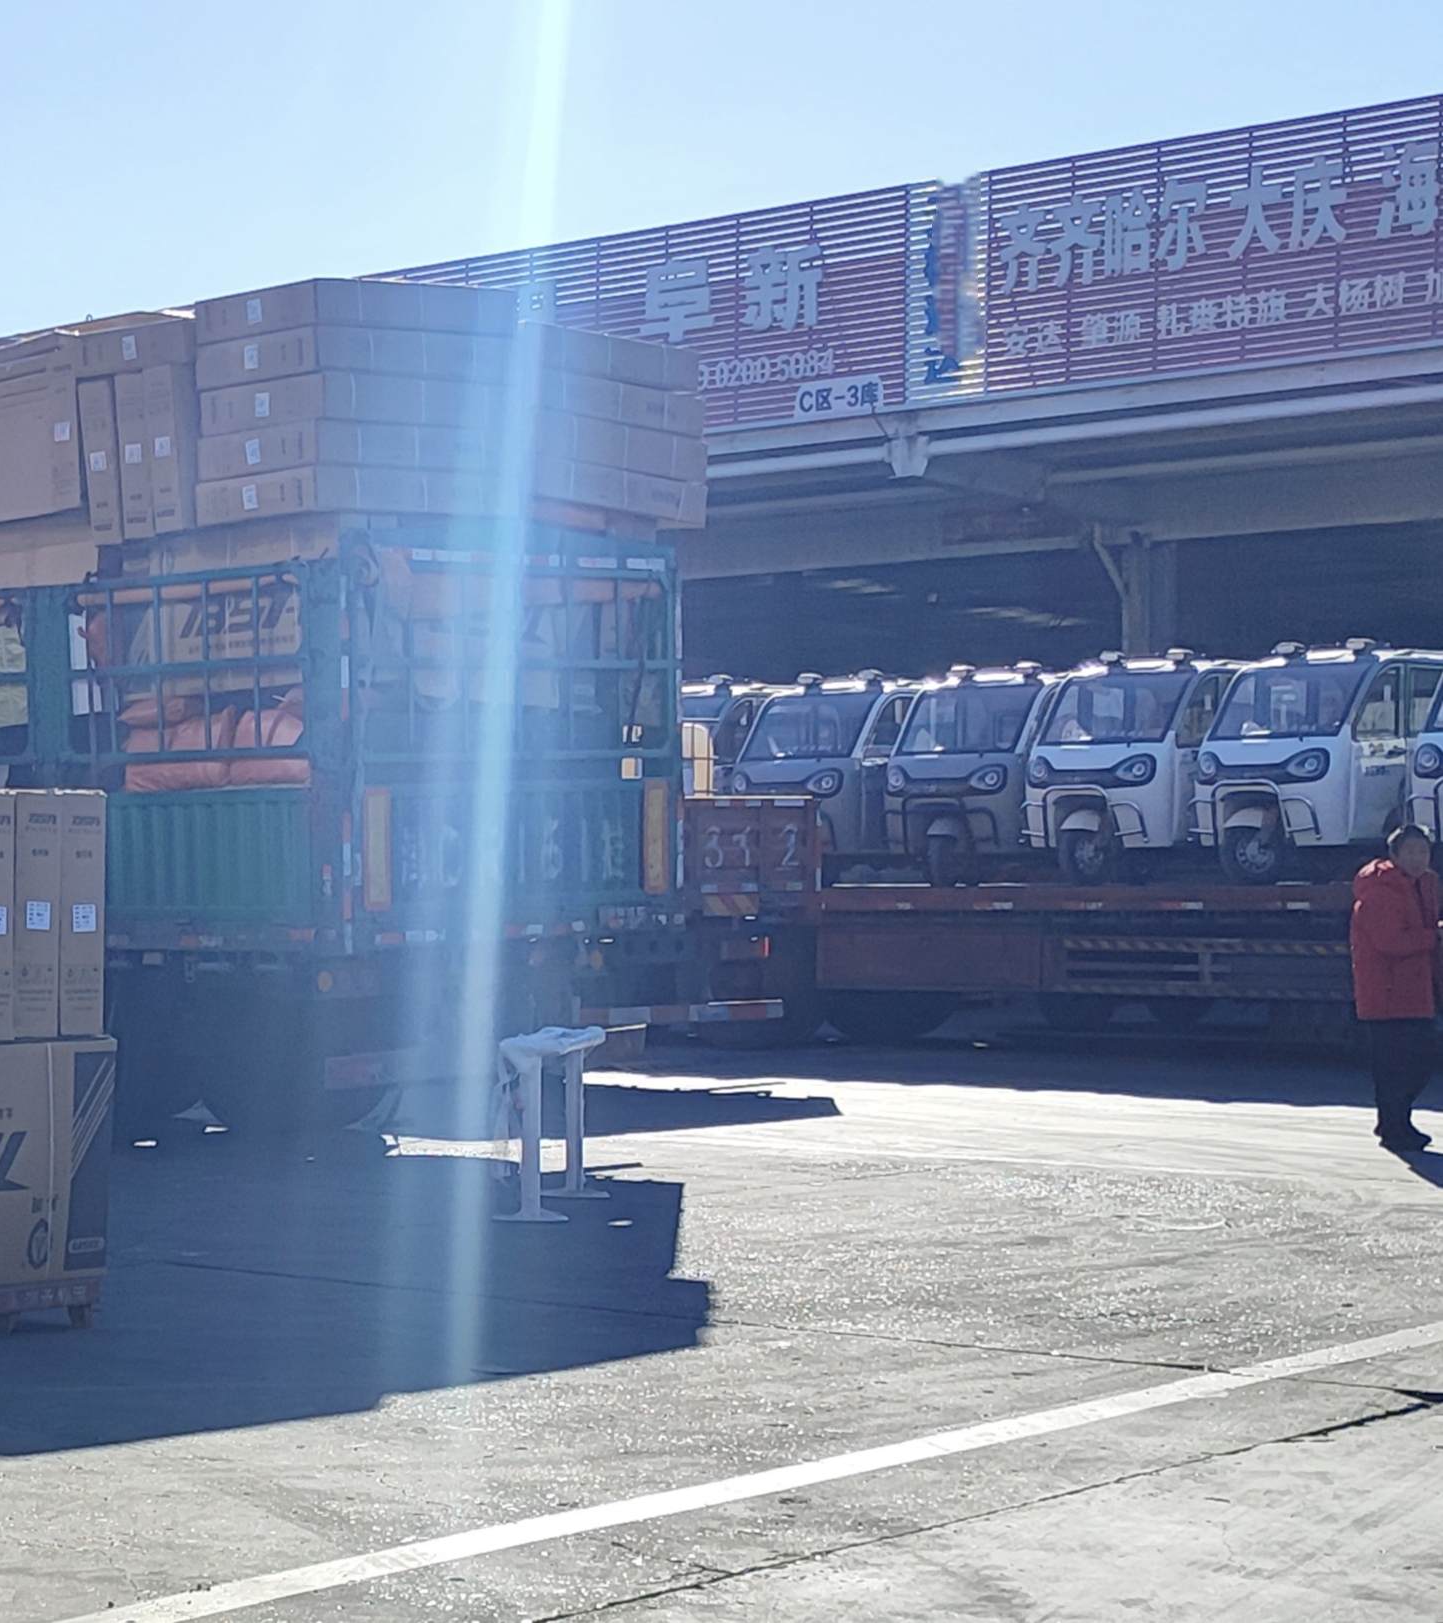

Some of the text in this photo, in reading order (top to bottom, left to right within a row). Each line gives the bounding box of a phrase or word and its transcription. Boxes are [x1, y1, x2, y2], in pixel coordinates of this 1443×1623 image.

[999, 179, 1208, 294] 齐齐哈尔
[1228, 156, 1347, 261] 大庆
[1376, 142, 1441, 239] 海
[639, 243, 823, 343] 阜新
